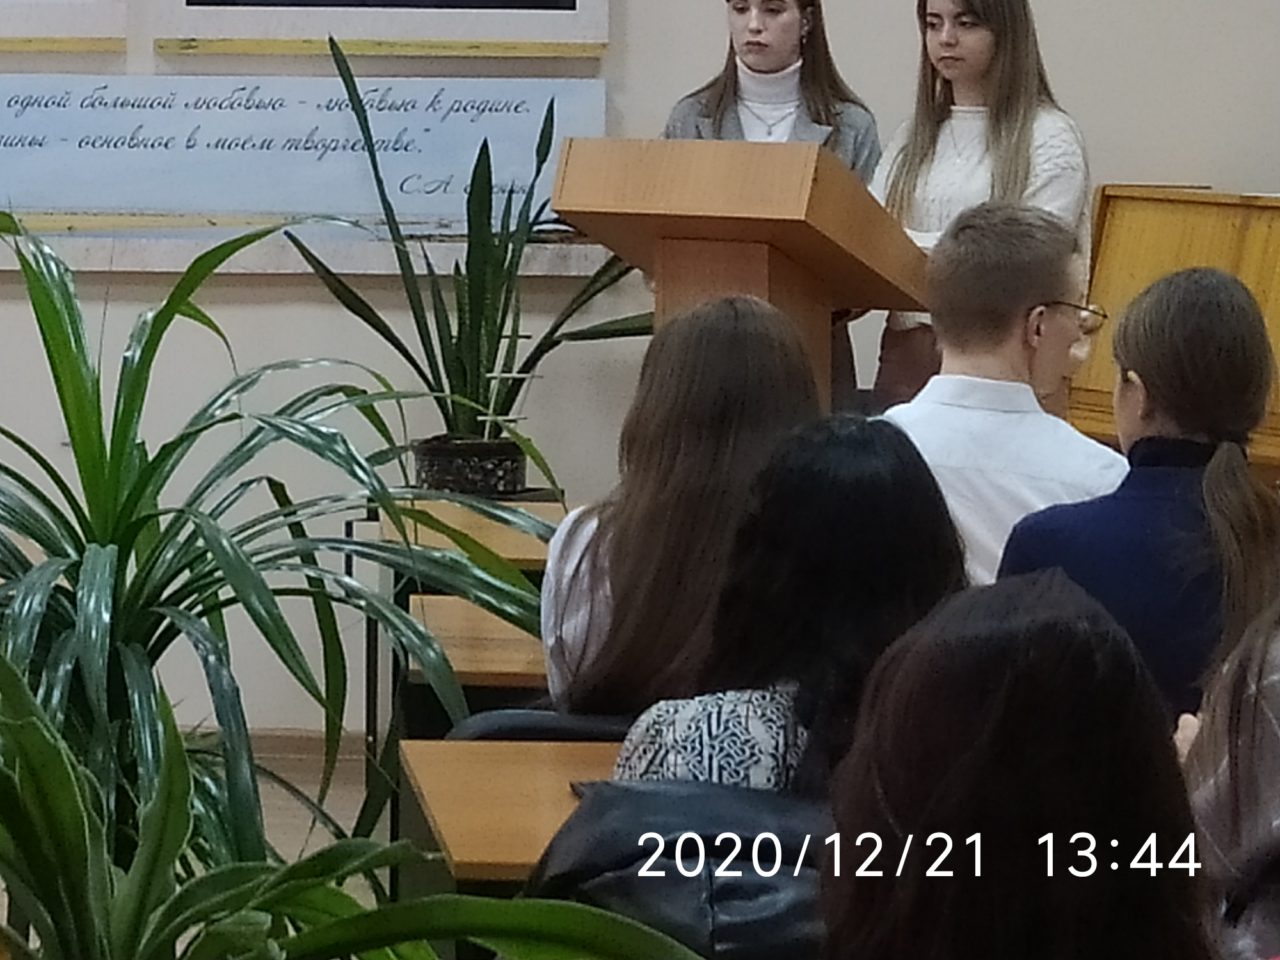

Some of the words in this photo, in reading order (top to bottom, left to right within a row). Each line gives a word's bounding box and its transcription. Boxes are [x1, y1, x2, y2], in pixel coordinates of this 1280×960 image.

[6, 90, 72, 119] одной
[79, 84, 178, 111] большой
[183, 85, 288, 112] любовью
[424, 87, 443, 113] к
[77, 123, 176, 151] основное
[184, 124, 202, 151] в
